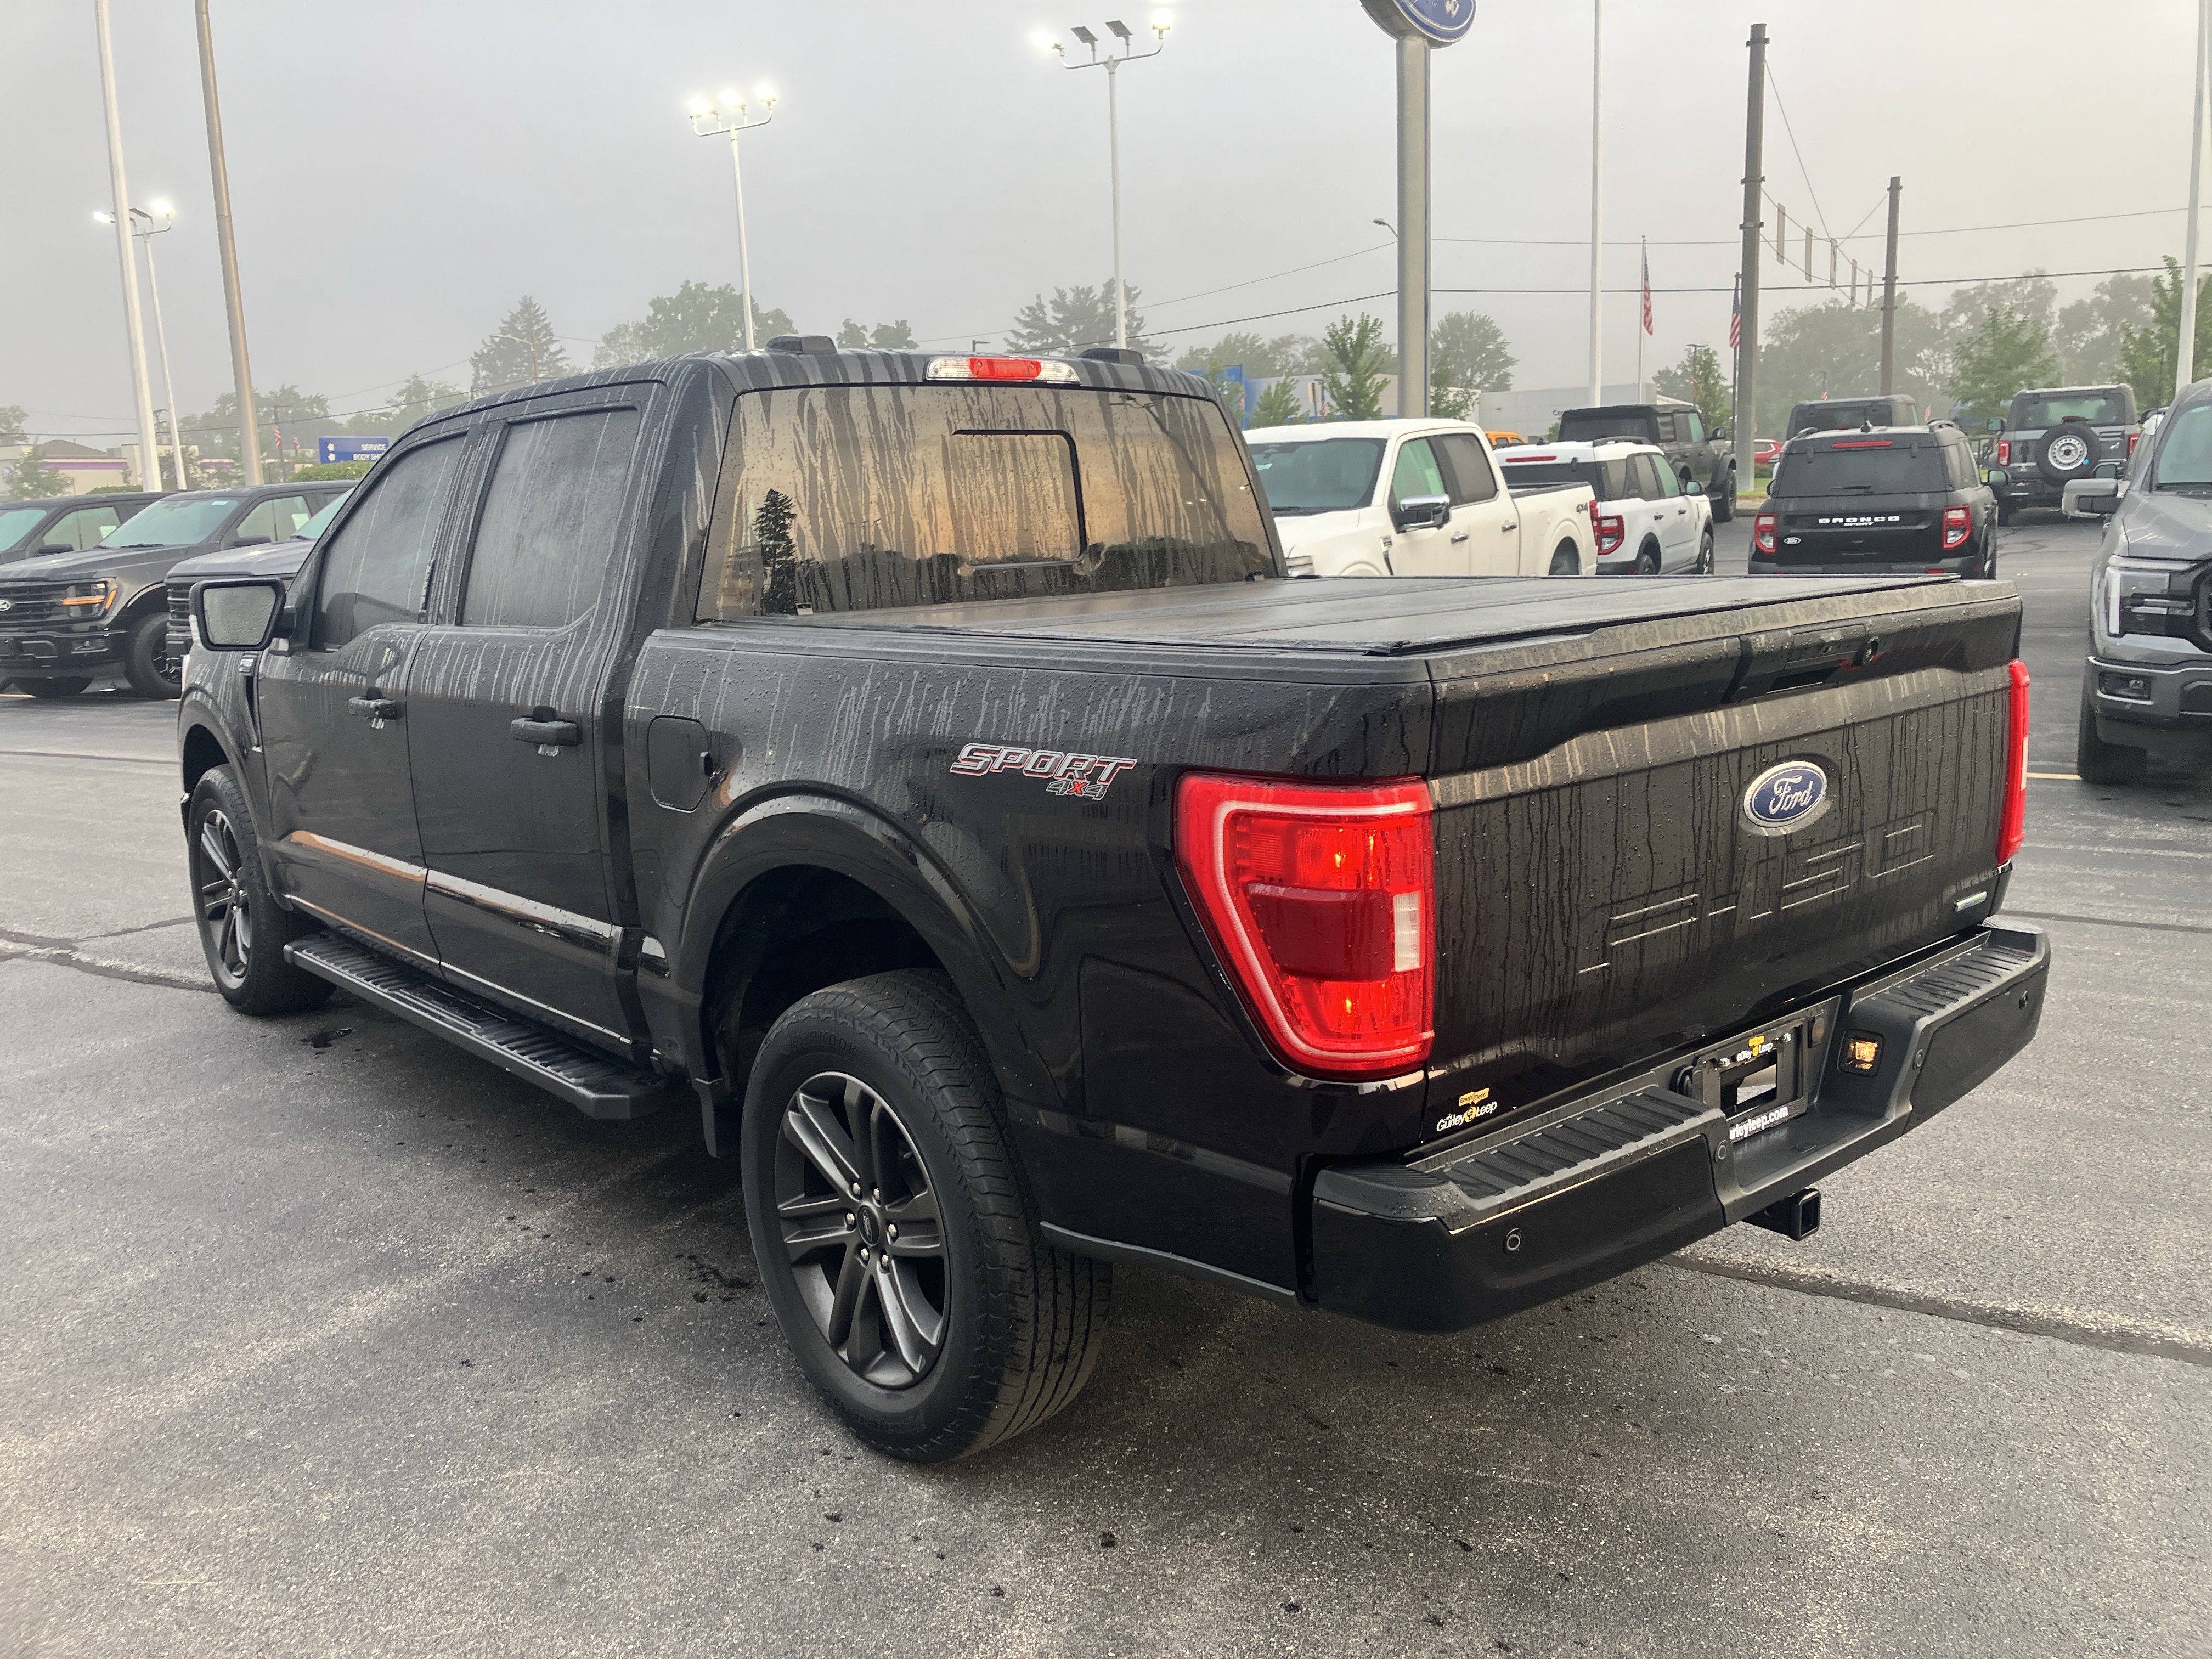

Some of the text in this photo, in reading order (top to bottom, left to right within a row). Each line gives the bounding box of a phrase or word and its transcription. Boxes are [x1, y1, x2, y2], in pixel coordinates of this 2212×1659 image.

[950, 743, 1137, 785] SPORT
[1769, 775, 1813, 815] Ford
[1759, 1042, 1773, 1053] Leep
[1436, 1113, 1466, 1131] Gurley
[1476, 1101, 1498, 1117] Leep
